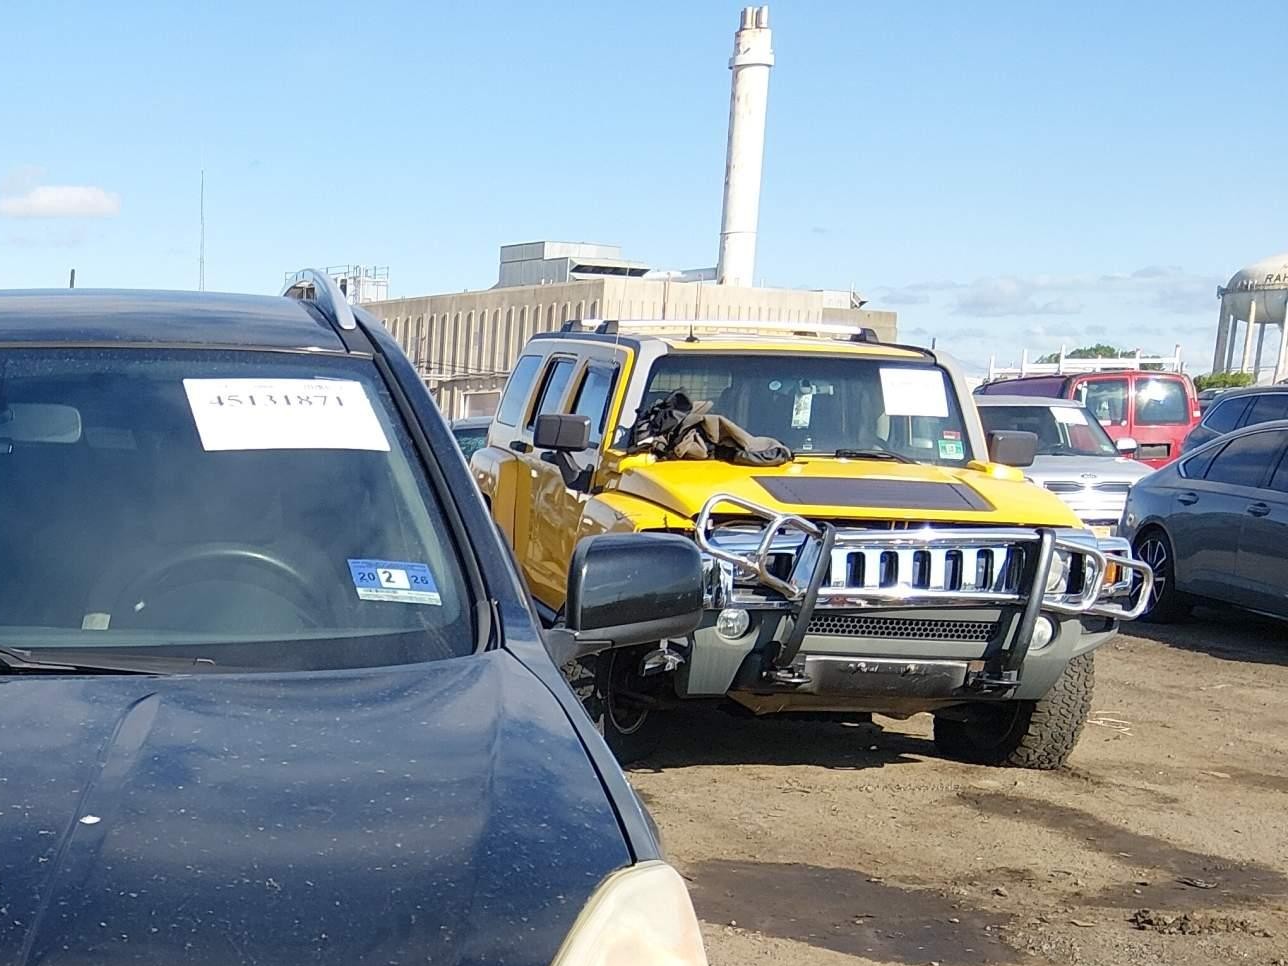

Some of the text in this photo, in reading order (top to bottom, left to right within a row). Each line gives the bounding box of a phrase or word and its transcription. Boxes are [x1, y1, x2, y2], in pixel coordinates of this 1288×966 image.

[210, 394, 344, 407] 45131871
[357, 570, 429, 585] 20 2 26
